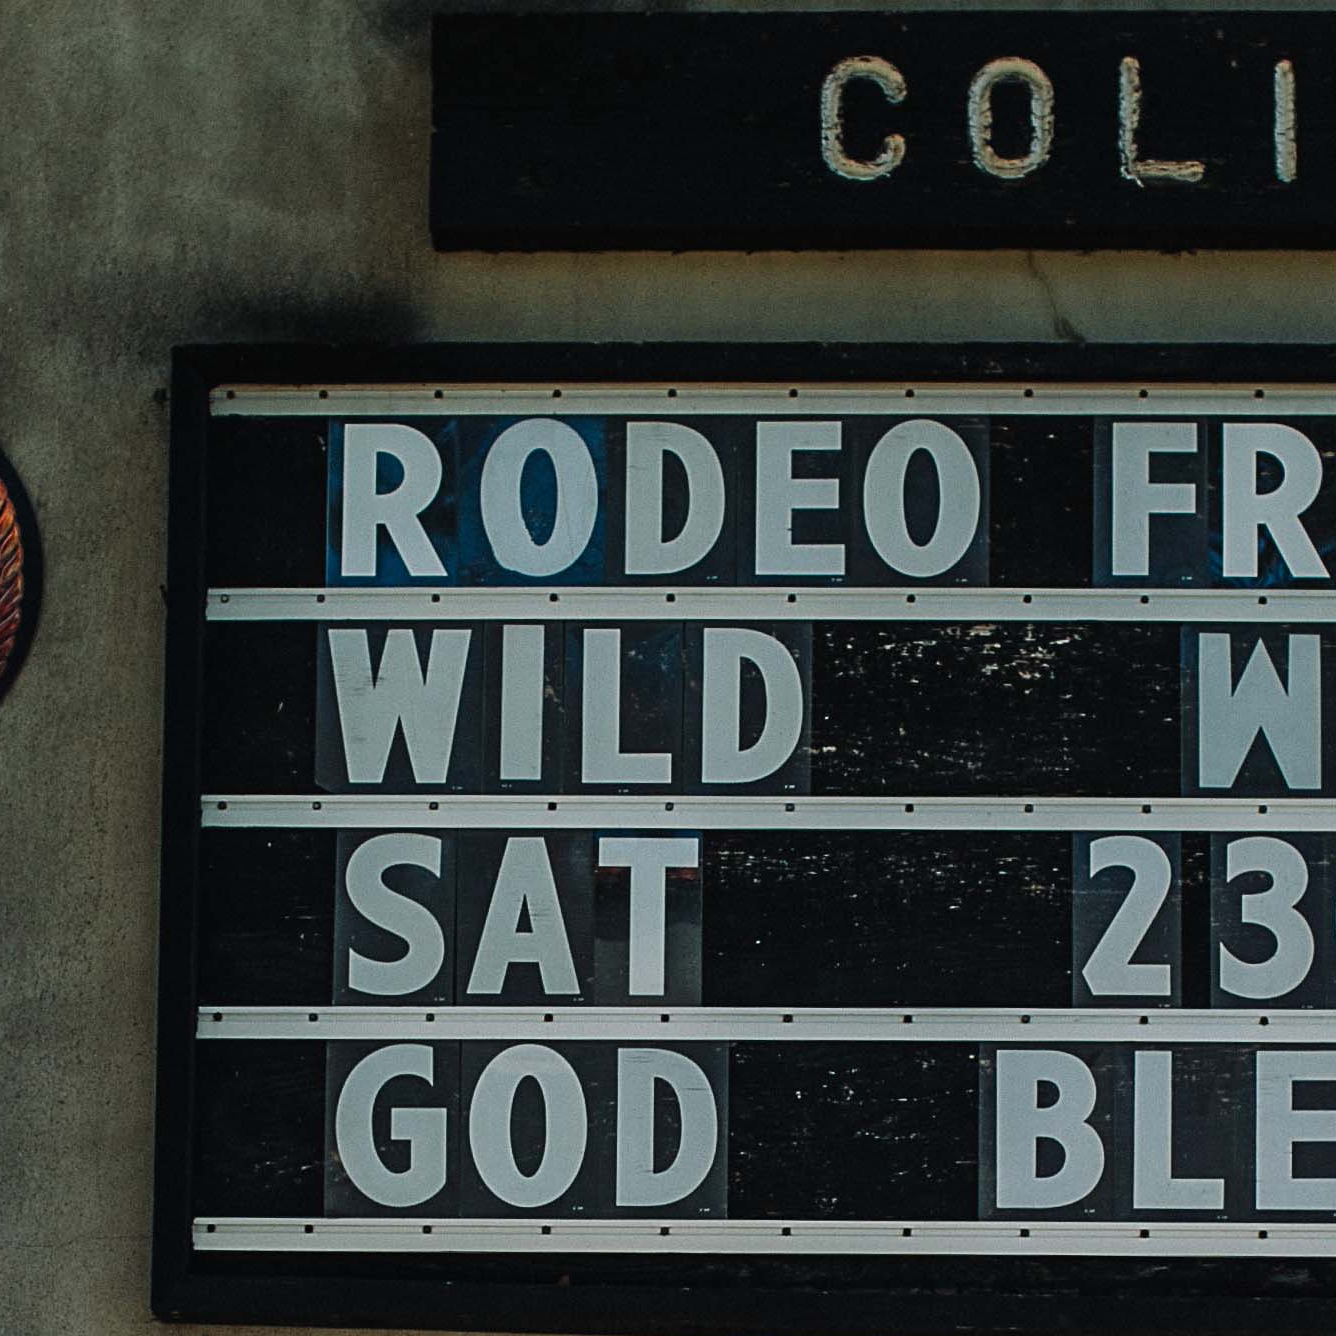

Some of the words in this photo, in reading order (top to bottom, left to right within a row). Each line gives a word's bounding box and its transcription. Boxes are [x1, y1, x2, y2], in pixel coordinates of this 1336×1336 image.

[341, 417, 981, 579] RODEO
[328, 626, 803, 785] WILD
[345, 832, 700, 998] SAT
[334, 1043, 719, 1209] GOD
